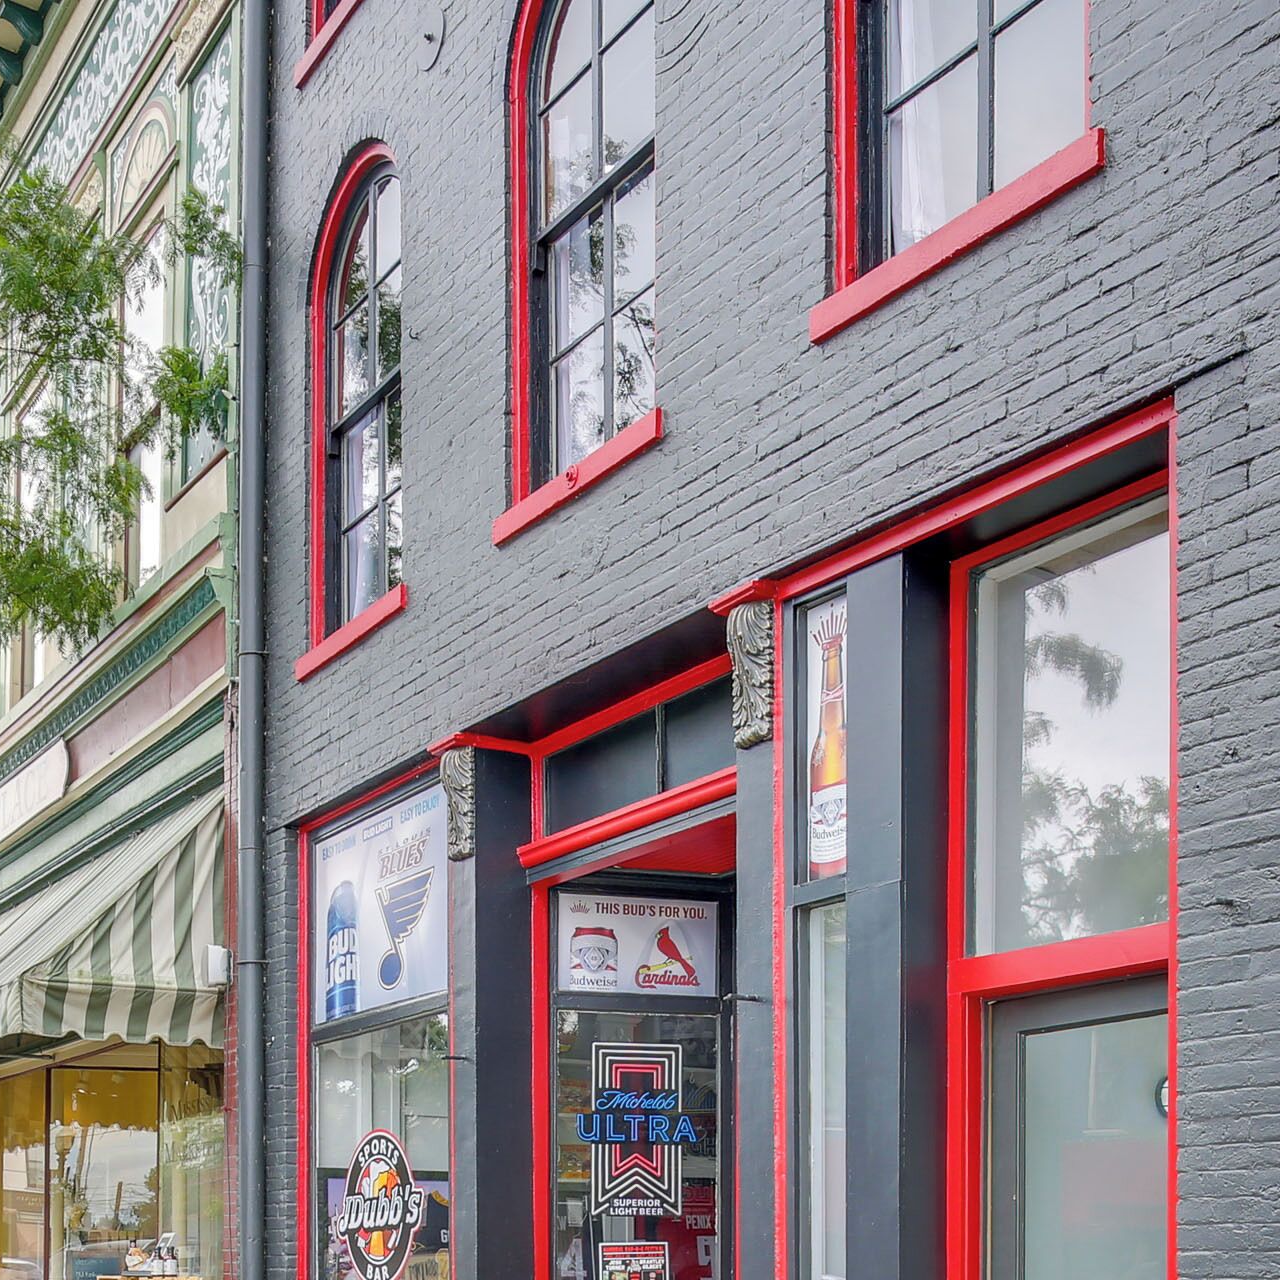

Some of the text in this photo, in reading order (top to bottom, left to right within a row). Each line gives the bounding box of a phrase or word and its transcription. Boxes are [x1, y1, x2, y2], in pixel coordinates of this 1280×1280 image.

[400, 805, 415, 824] EASY
[812, 825, 847, 839] Budweis
[378, 837, 429, 880] BLUES
[595, 902, 708, 920] THIS BUD'S FOR YOU.
[569, 974, 618, 987] Budweise
[635, 964, 701, 989] Cardinals
[596, 1090, 679, 1110] Michelob
[576, 1113, 698, 1143] ULTRA
[358, 1138, 400, 1168] SPORTS
[339, 1185, 422, 1233] JDubb's
[610, 1207, 664, 1216] LIGHT BEER
[613, 1199, 661, 1208] SUPERIOR
[685, 1215, 713, 1230] PENIX
